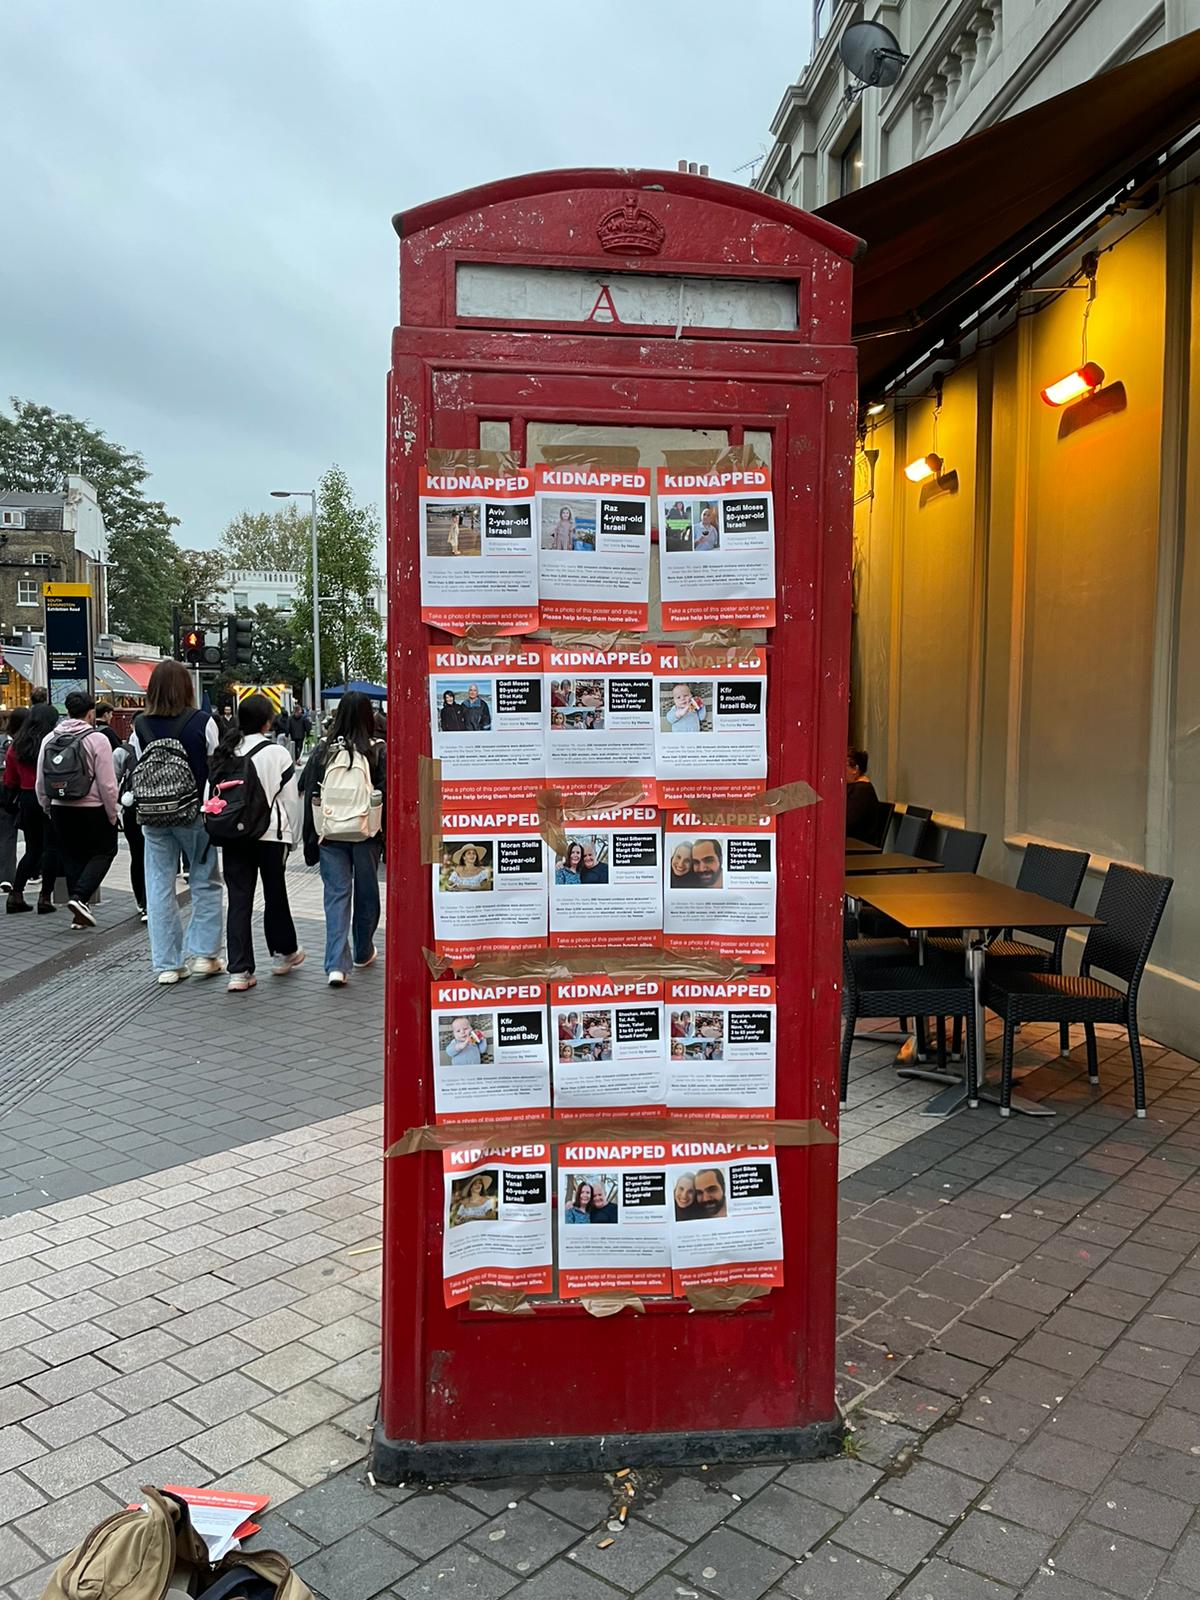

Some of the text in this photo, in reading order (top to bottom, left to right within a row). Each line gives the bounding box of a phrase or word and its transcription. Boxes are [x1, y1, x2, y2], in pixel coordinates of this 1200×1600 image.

[585, 285, 623, 323] A
[426, 476, 529, 491] KIDNAPPED
[542, 471, 646, 488] KIDNAPPED
[665, 472, 766, 487] KIDNAPPED
[488, 508, 506, 516] Aviv
[604, 504, 619, 512] Raz
[488, 517, 529, 527] 2-year-old
[603, 514, 643, 523] 4-year-old
[726, 512, 765, 521] 80-year-old
[488, 527, 512, 535] Israeli
[603, 523, 626, 531] Israeli
[436, 653, 540, 667] KIDNAPPED
[551, 653, 652, 666] KIDNAPPED
[740, 702, 758, 711] Baby
[441, 813, 540, 828] KIDNAPPED
[563, 807, 657, 821] NAPPED
[521, 841, 539, 849] Stella
[501, 857, 536, 865] 40-year-old
[438, 985, 541, 1002] KIDNAPPED
[558, 982, 659, 998] KIDNAPPED
[671, 985, 771, 998] KIDNAPPED
[501, 1033, 539, 1041] Israeli Baby
[450, 1144, 545, 1165] KIDNAPPED
[565, 1145, 665, 1160] KIDNAPPED
